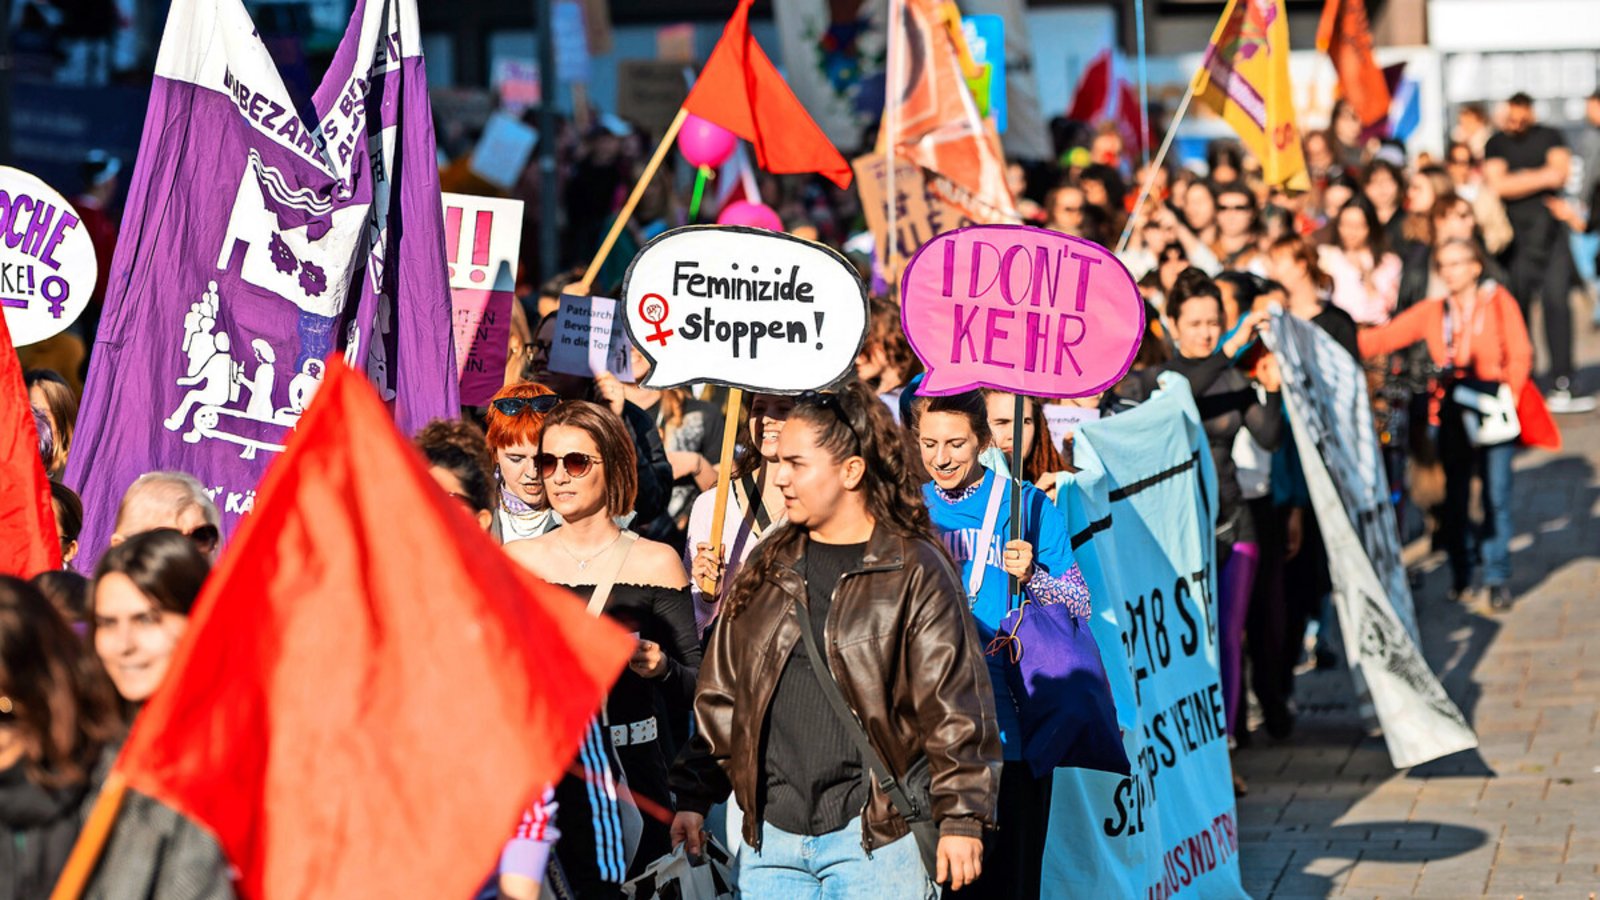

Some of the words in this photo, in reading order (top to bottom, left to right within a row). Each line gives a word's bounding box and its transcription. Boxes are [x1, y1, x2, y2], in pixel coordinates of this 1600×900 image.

[672, 261, 815, 303] Feminizide
[942, 239, 956, 298] I
[968, 240, 1103, 313] DON'T
[561, 334, 571, 344] in
[574, 337, 589, 348] die
[950, 304, 1088, 377] KEHR
